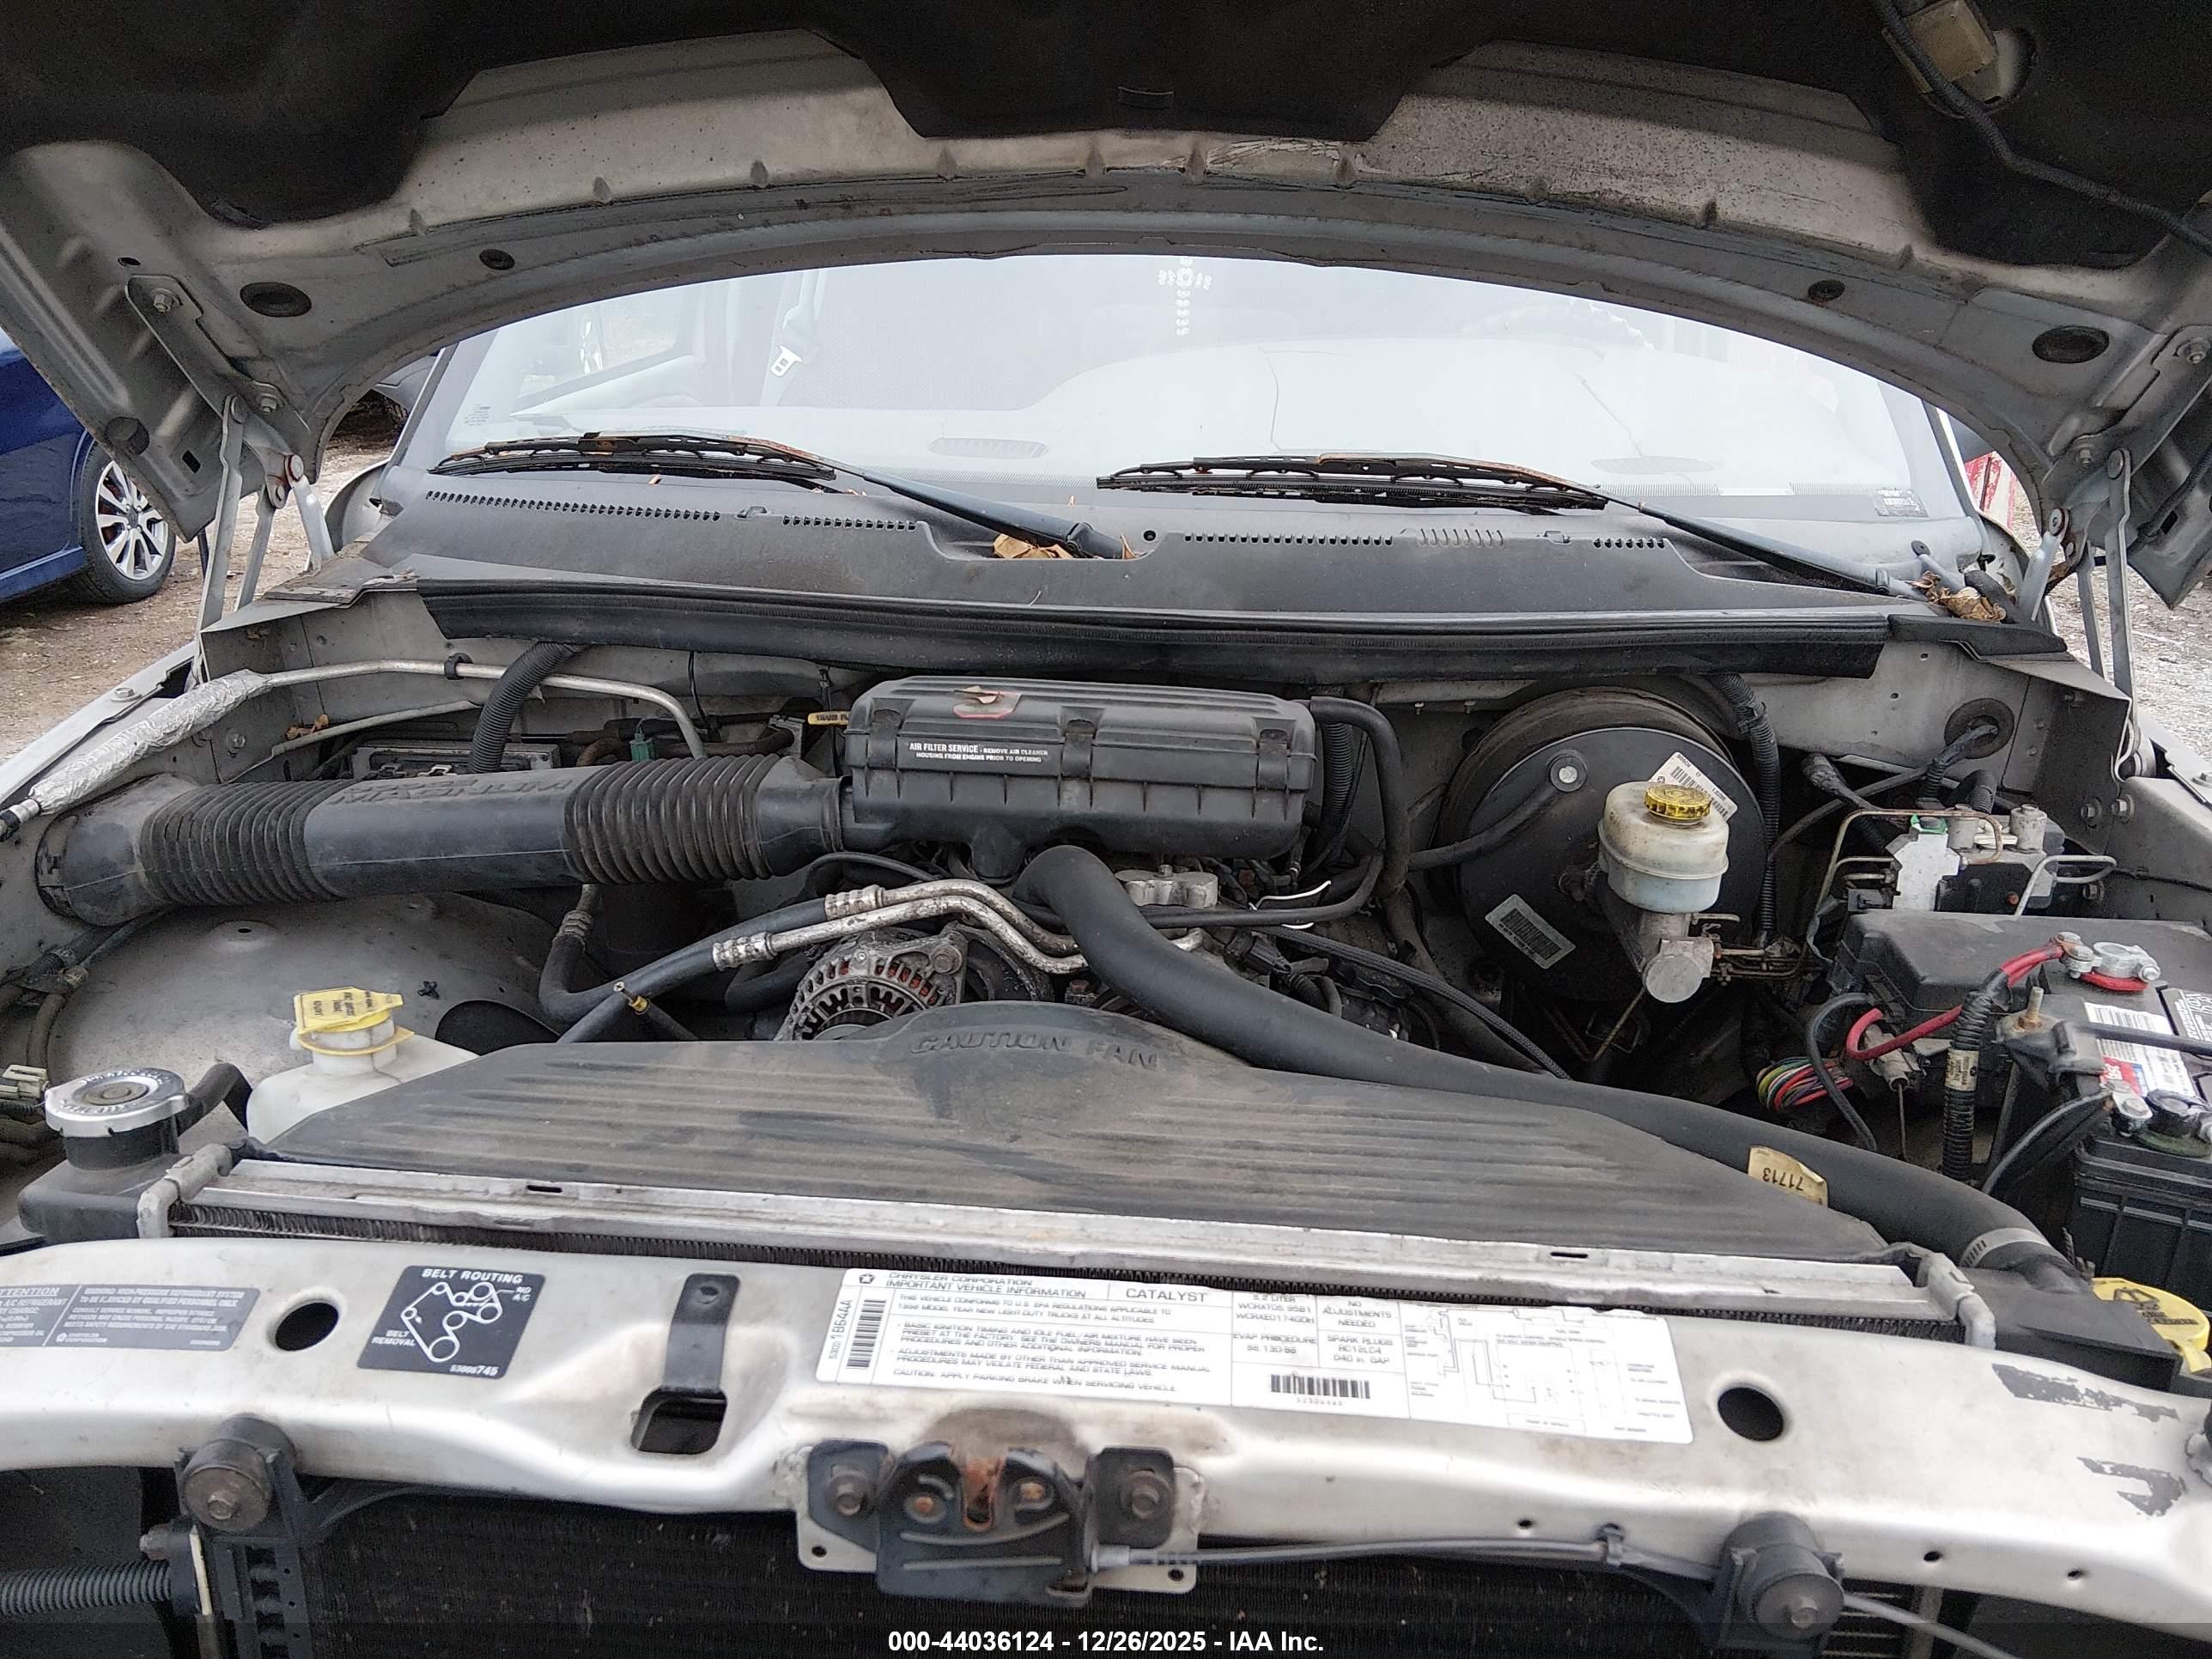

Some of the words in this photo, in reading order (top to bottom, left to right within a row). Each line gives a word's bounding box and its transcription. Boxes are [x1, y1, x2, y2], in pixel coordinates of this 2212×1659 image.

[909, 742, 922, 750] AIR
[923, 743, 948, 752] FILTER
[948, 744, 979, 753] SERVICE
[910, 1030, 1068, 1054] CAUTION
[1085, 1037, 1158, 1071] FAN
[1762, 1167, 1803, 1192] 71713
[421, 1268, 456, 1279] BELT
[460, 1270, 524, 1285] ROUTING
[888, 1272, 948, 1281] CHRYSLER
[951, 1276, 1032, 1286] CORPORATION
[0, 1287, 60, 1297] TTENTION
[886, 1279, 953, 1291] IMPORTANT
[957, 1283, 1003, 1293] VEHICLE
[1006, 1285, 1085, 1298] INFORMATION
[1126, 1287, 1208, 1303] CATALYST
[1271, 1295, 1297, 1304] LITER
[1052, 1303, 1108, 1312] REGULATIONS
[1110, 1305, 1158, 1314] APPLICABLE
[1322, 1306, 1392, 1319] ADJUSTMENTS
[1338, 1319, 1376, 1328] NEEDED
[385, 1329, 410, 1338] BELT
[1261, 1334, 1317, 1345] PROCEDURE
[1328, 1334, 1358, 1343] SPARK
[1362, 1336, 1393, 1346] PLUGS
[371, 1336, 417, 1346] REMOVAL
[900, 1336, 962, 1346] PROCEDURES
[988, 1340, 1018, 1348] OTHER
[1020, 1343, 1073, 1352] ADDITIONAL
[1104, 1340, 1144, 1348] MANUAL
[1168, 1344, 1206, 1353] PROPER
[896, 1356, 958, 1365] PROCEDURES
[961, 1358, 982, 1367] MAY
[986, 1360, 1022, 1369] VIOLATE
[898, 1348, 967, 1358] ADJUSTMENTS
[1077, 1358, 1127, 1367] APPROVED
[1130, 1362, 1168, 1370] SERVICE
[940, 1370, 970, 1379] APPLY
[973, 1373, 1015, 1382] PARKING
[1053, 1376, 1082, 1386] WHEN
[1085, 1381, 1135, 1389] SERVICING
[1139, 1382, 1176, 1392] VEHICLE
